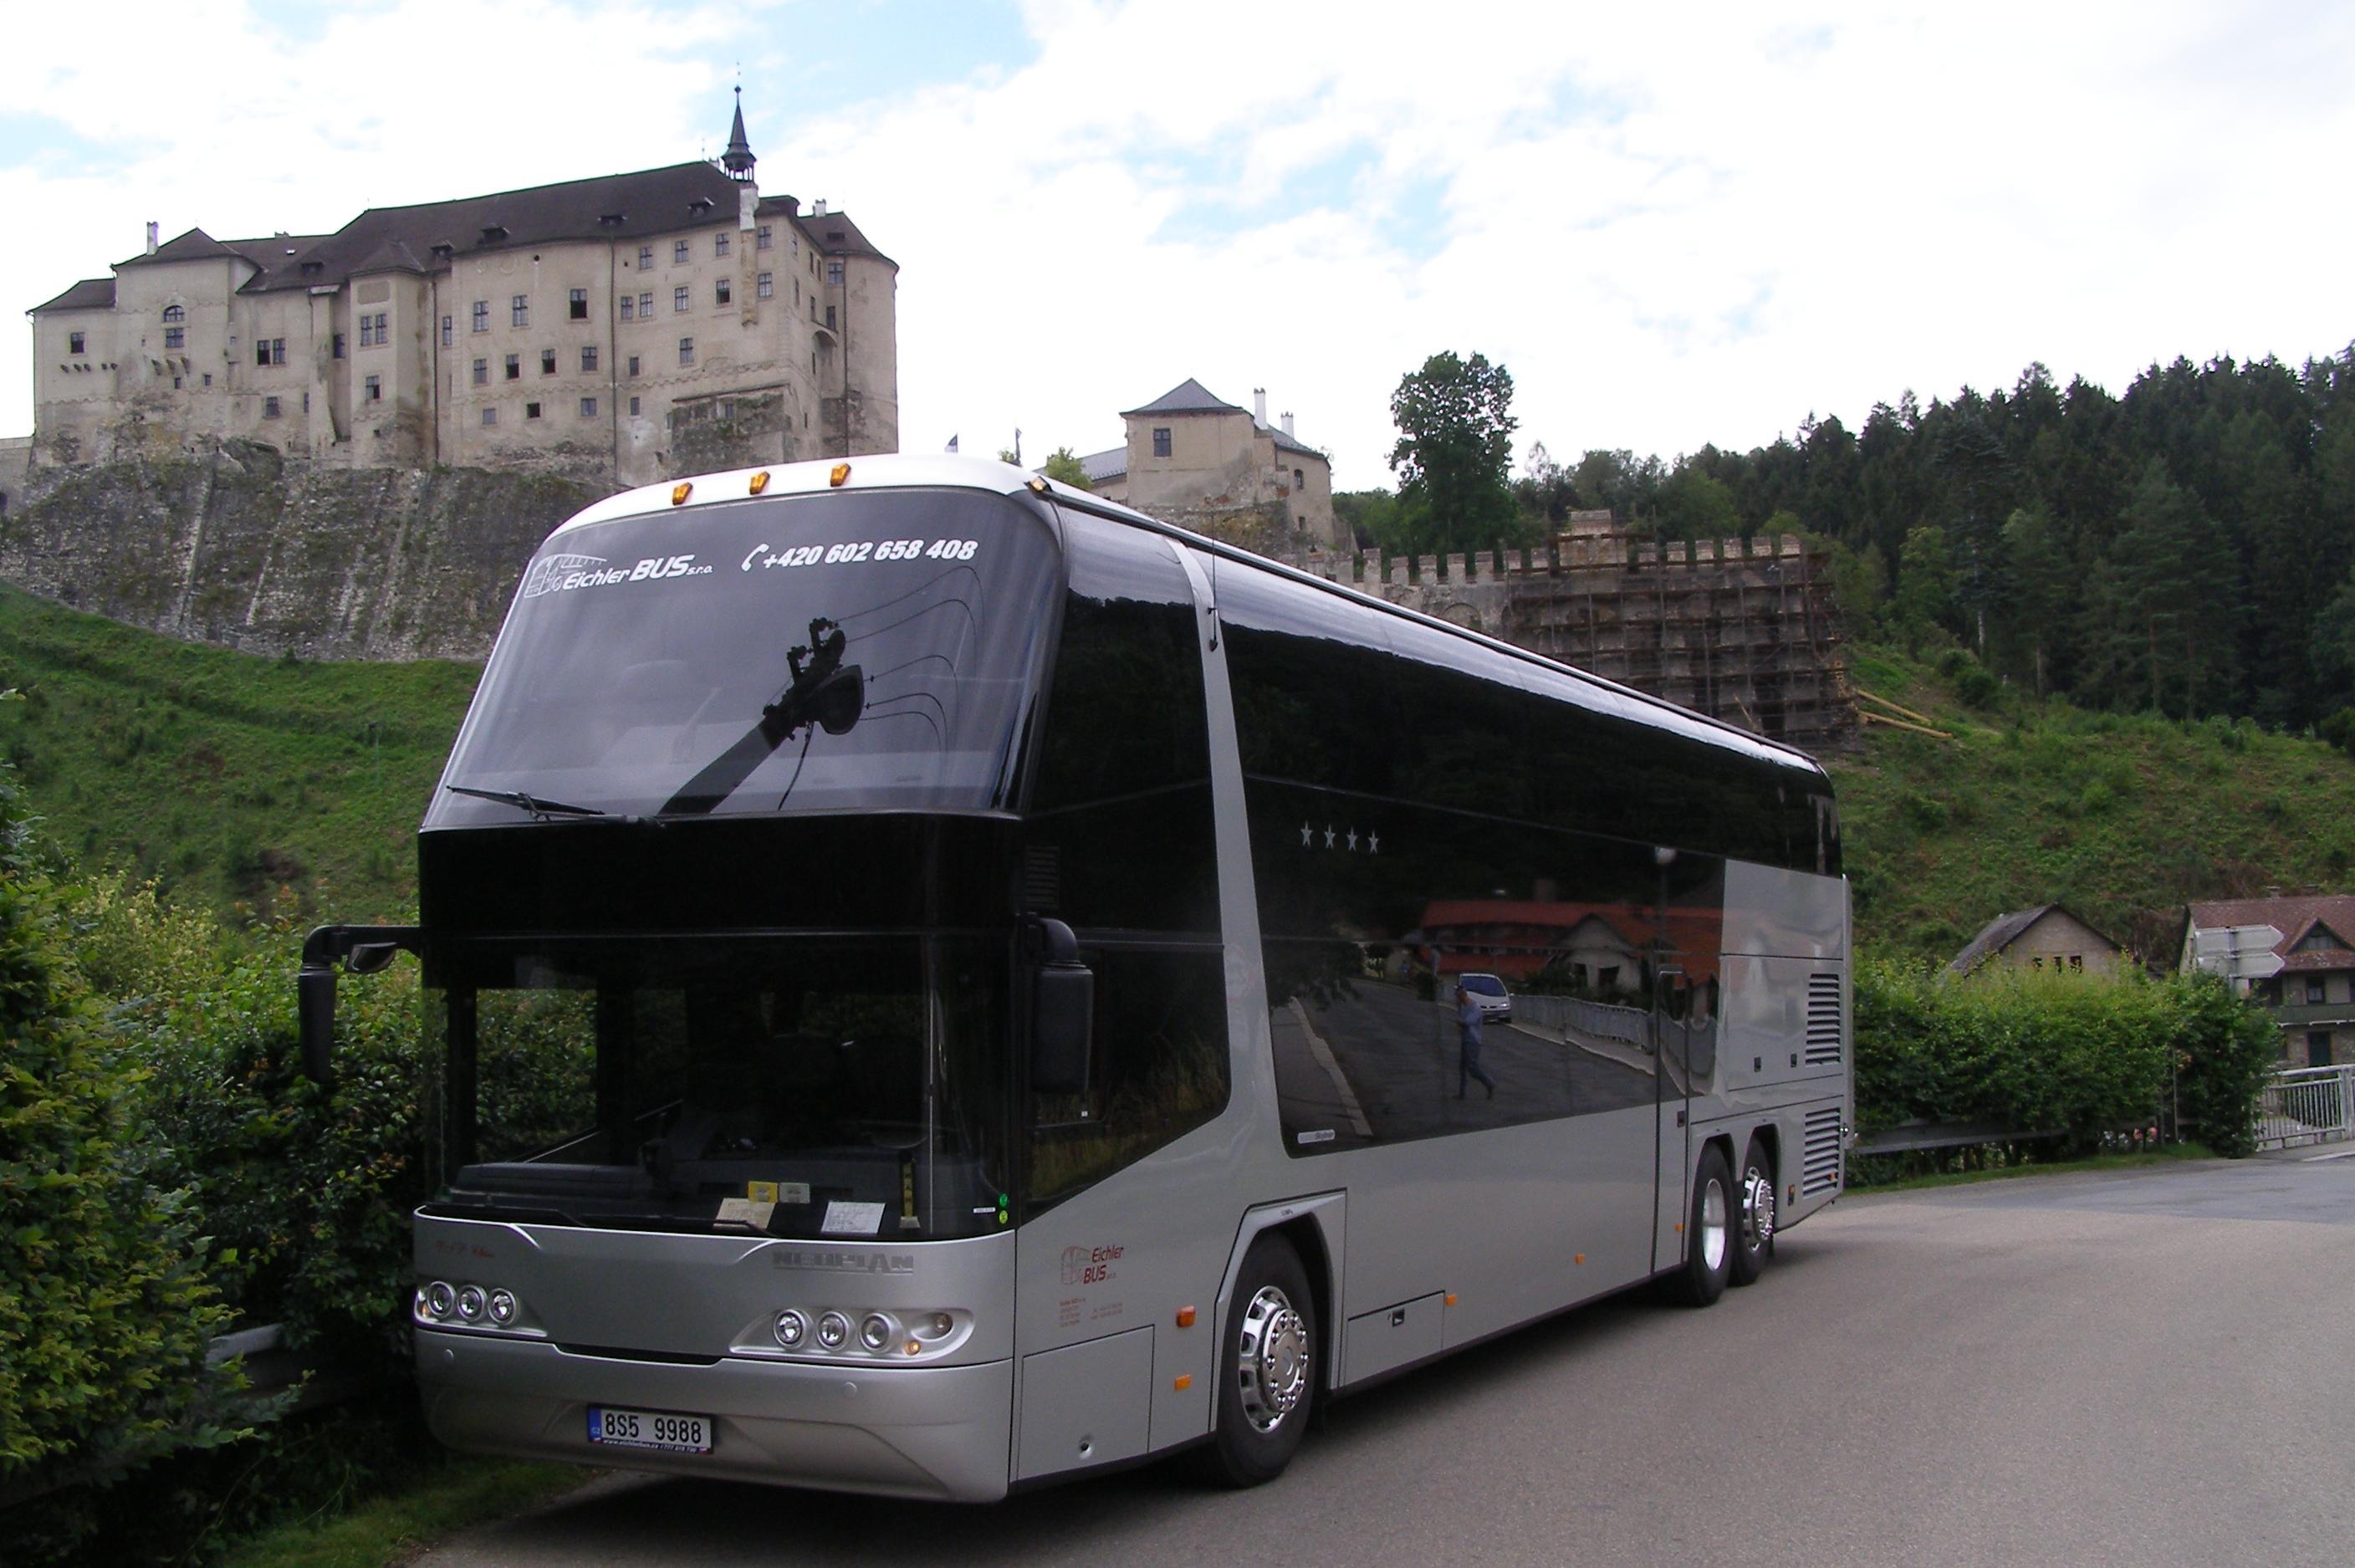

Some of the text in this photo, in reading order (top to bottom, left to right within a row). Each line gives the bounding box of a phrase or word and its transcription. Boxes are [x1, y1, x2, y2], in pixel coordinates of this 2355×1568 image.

[763, 539, 979, 569] +420 602 658 408
[563, 567, 630, 590] Eichler
[629, 554, 696, 581] BUS
[1091, 1244, 1124, 1263] Eichler
[1083, 1264, 1107, 1285] BUS
[605, 1412, 702, 1444] 8S5 9988
